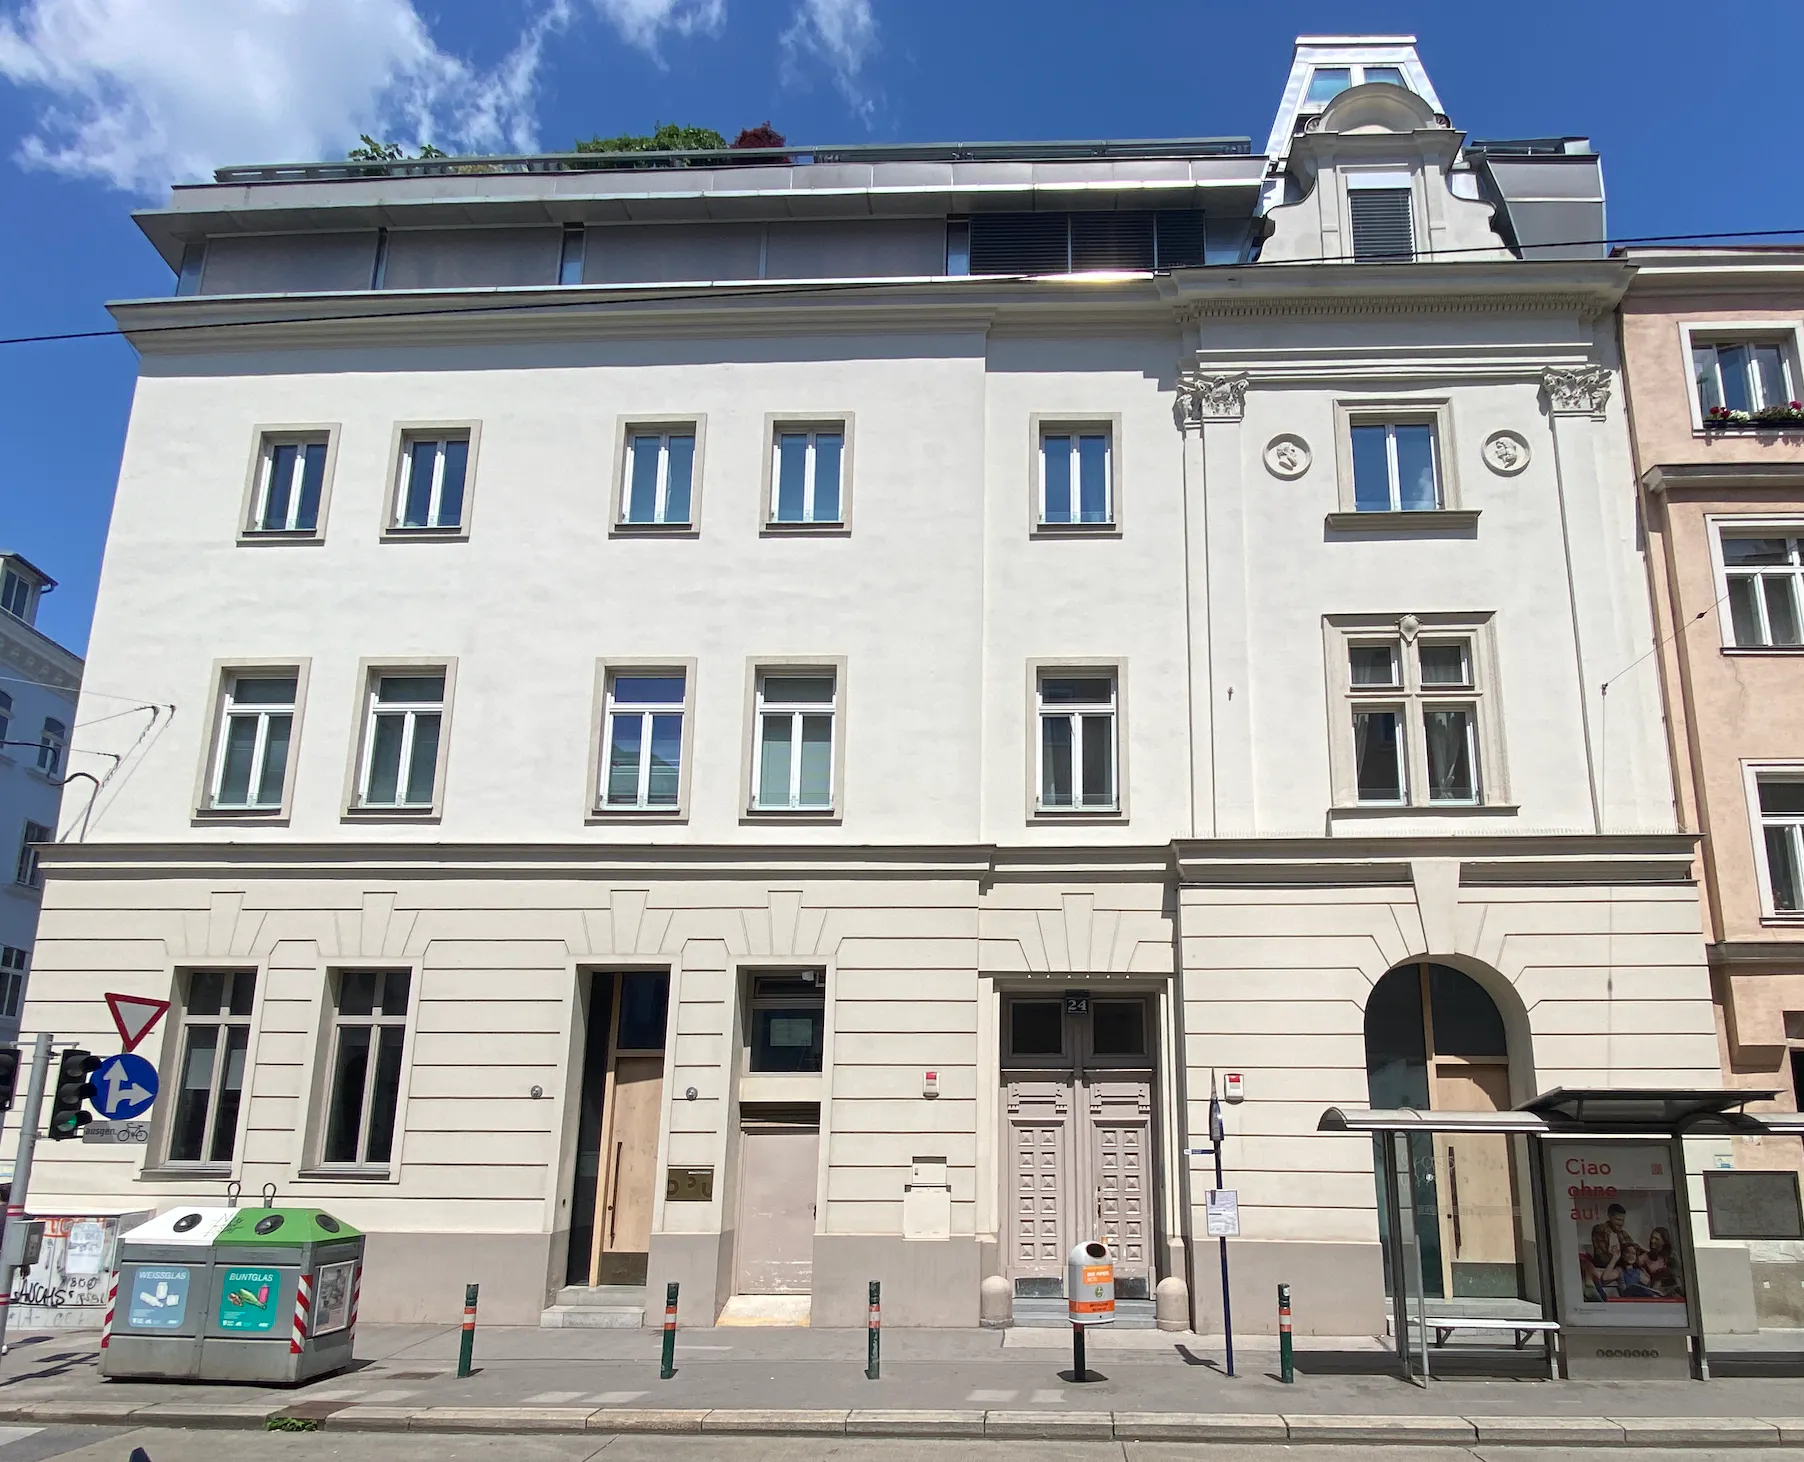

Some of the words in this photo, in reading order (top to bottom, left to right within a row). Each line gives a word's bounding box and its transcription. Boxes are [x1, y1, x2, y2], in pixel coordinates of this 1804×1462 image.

[1067, 999, 1087, 1011] 24
[1565, 1158, 1611, 1175] Ciao
[1568, 1180, 1617, 1197] ohne
[1570, 1203, 1599, 1220] au!
[139, 1271, 187, 1280] WEISSGLAS
[229, 1273, 273, 1282] BUNTGLAS
